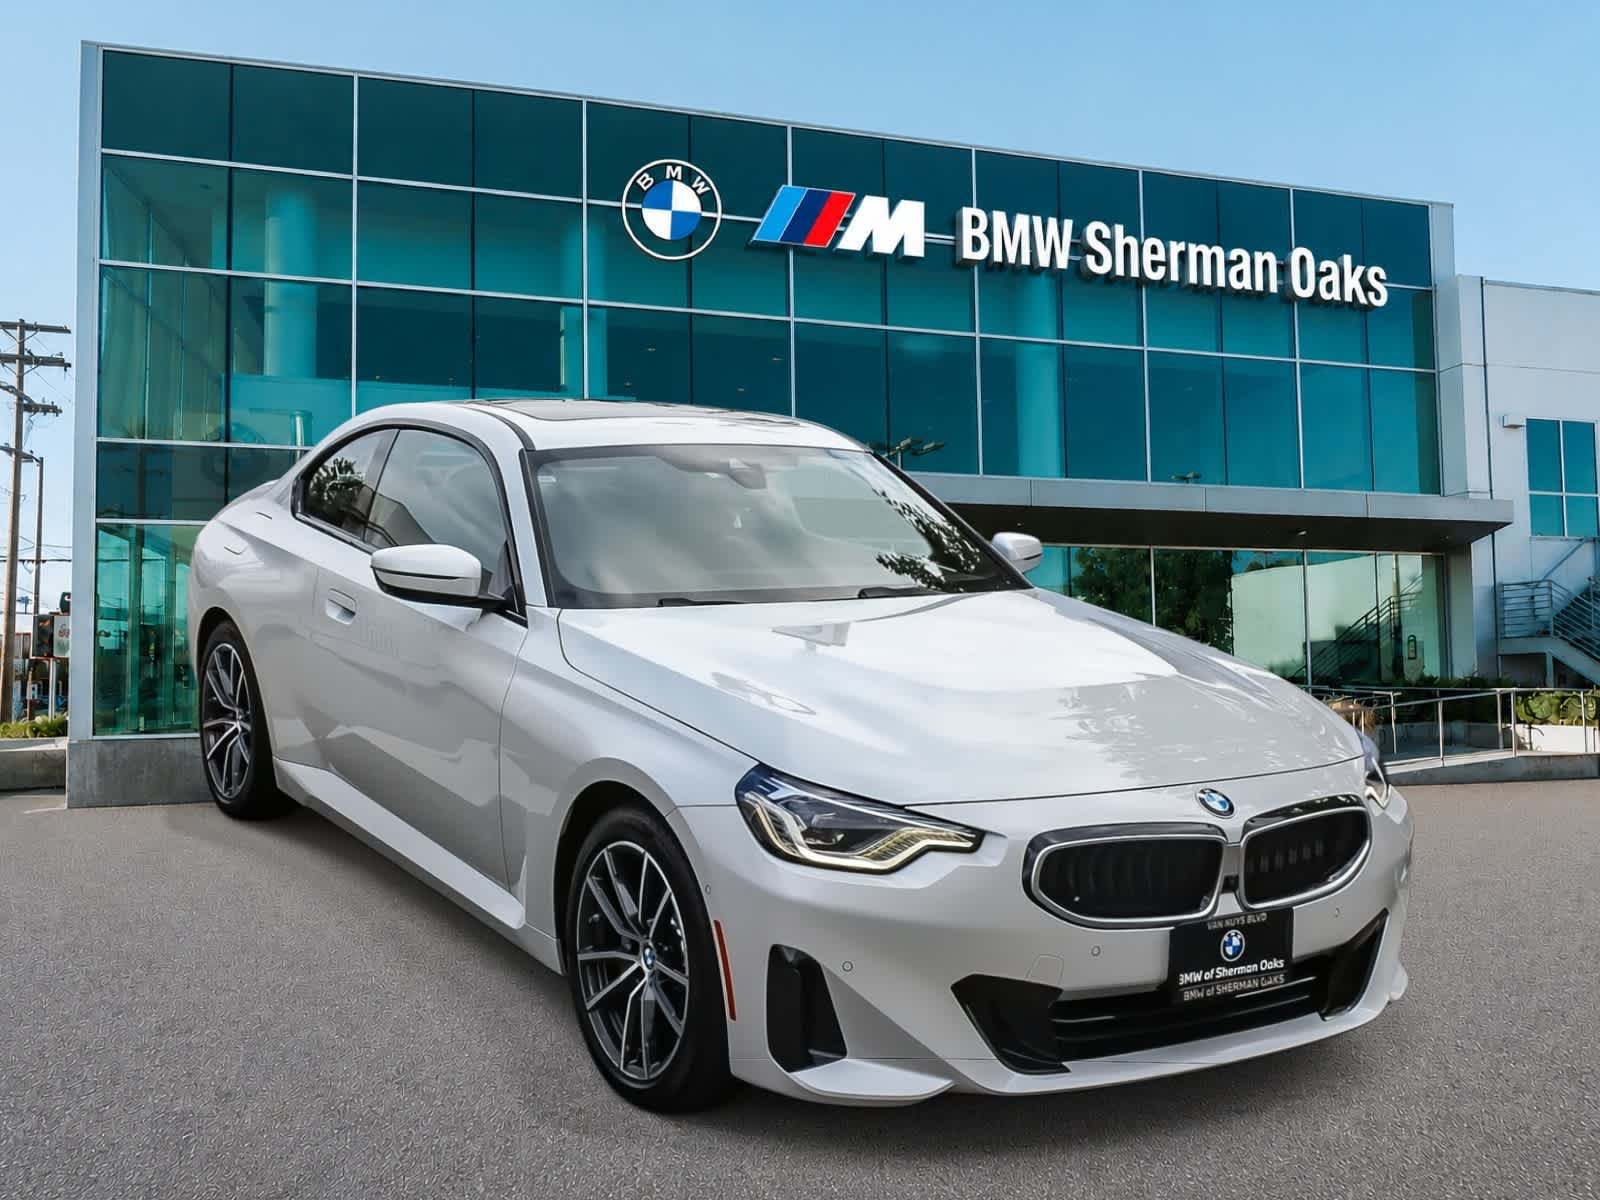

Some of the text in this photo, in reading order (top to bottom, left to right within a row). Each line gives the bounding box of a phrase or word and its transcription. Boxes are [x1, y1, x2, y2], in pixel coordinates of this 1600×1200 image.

[636, 165, 711, 196] BMW
[959, 206, 1388, 308] BMW Sherman Oaks
[1204, 968, 1215, 980] of
[1216, 963, 1258, 979] Sherman
[1260, 958, 1285, 970] Oaks
[1184, 974, 1285, 1001] BMW of SHERMAN OAKS
